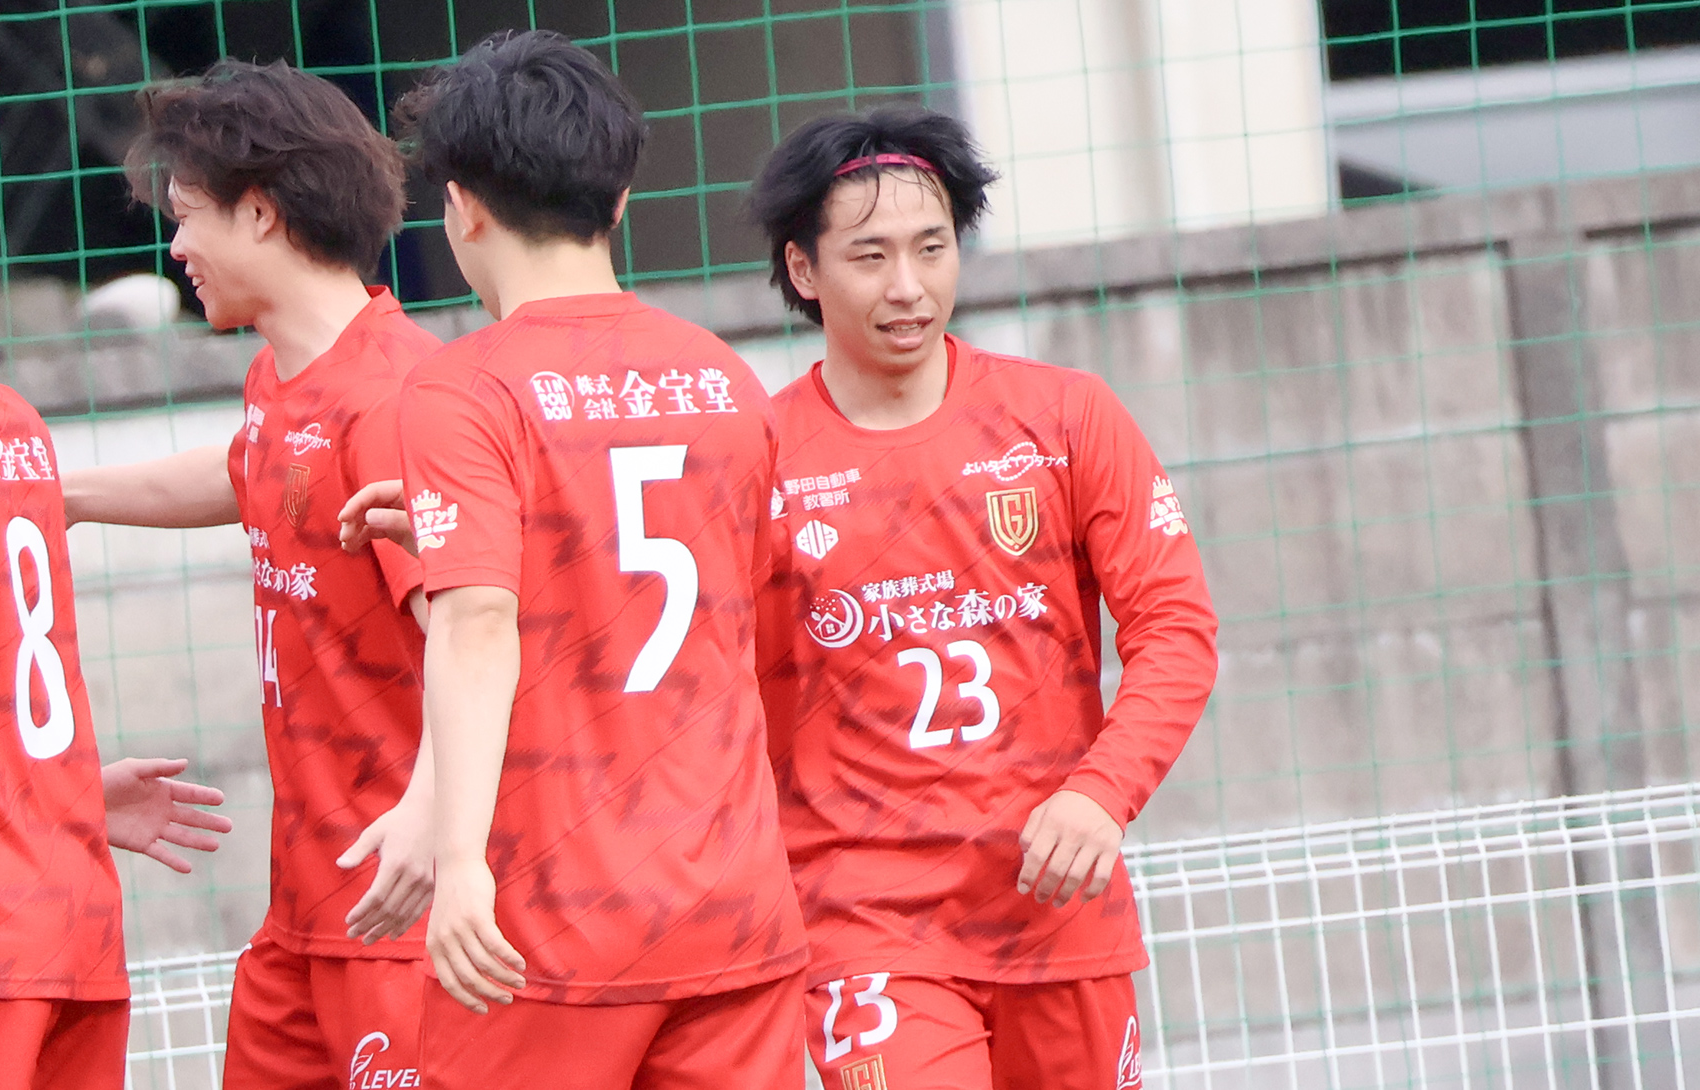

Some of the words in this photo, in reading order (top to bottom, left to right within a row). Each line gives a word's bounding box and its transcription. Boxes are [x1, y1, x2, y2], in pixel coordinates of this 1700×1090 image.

[532, 378, 565, 393] KIN
[538, 392, 570, 406] POU
[575, 374, 613, 396] 株式
[619, 368, 738, 418] 金宝堂
[543, 405, 573, 421] DOU
[584, 398, 619, 420] 会社
[784, 468, 862, 495] 野田自動車
[802, 488, 851, 511] 教習所
[608, 445, 699, 692] 5
[861, 570, 955, 603] 家族葬式場
[868, 582, 1049, 642] 小さな森の家
[5, 516, 75, 759] 8
[897, 639, 1000, 749] 23
[823, 972, 898, 1063] 23
